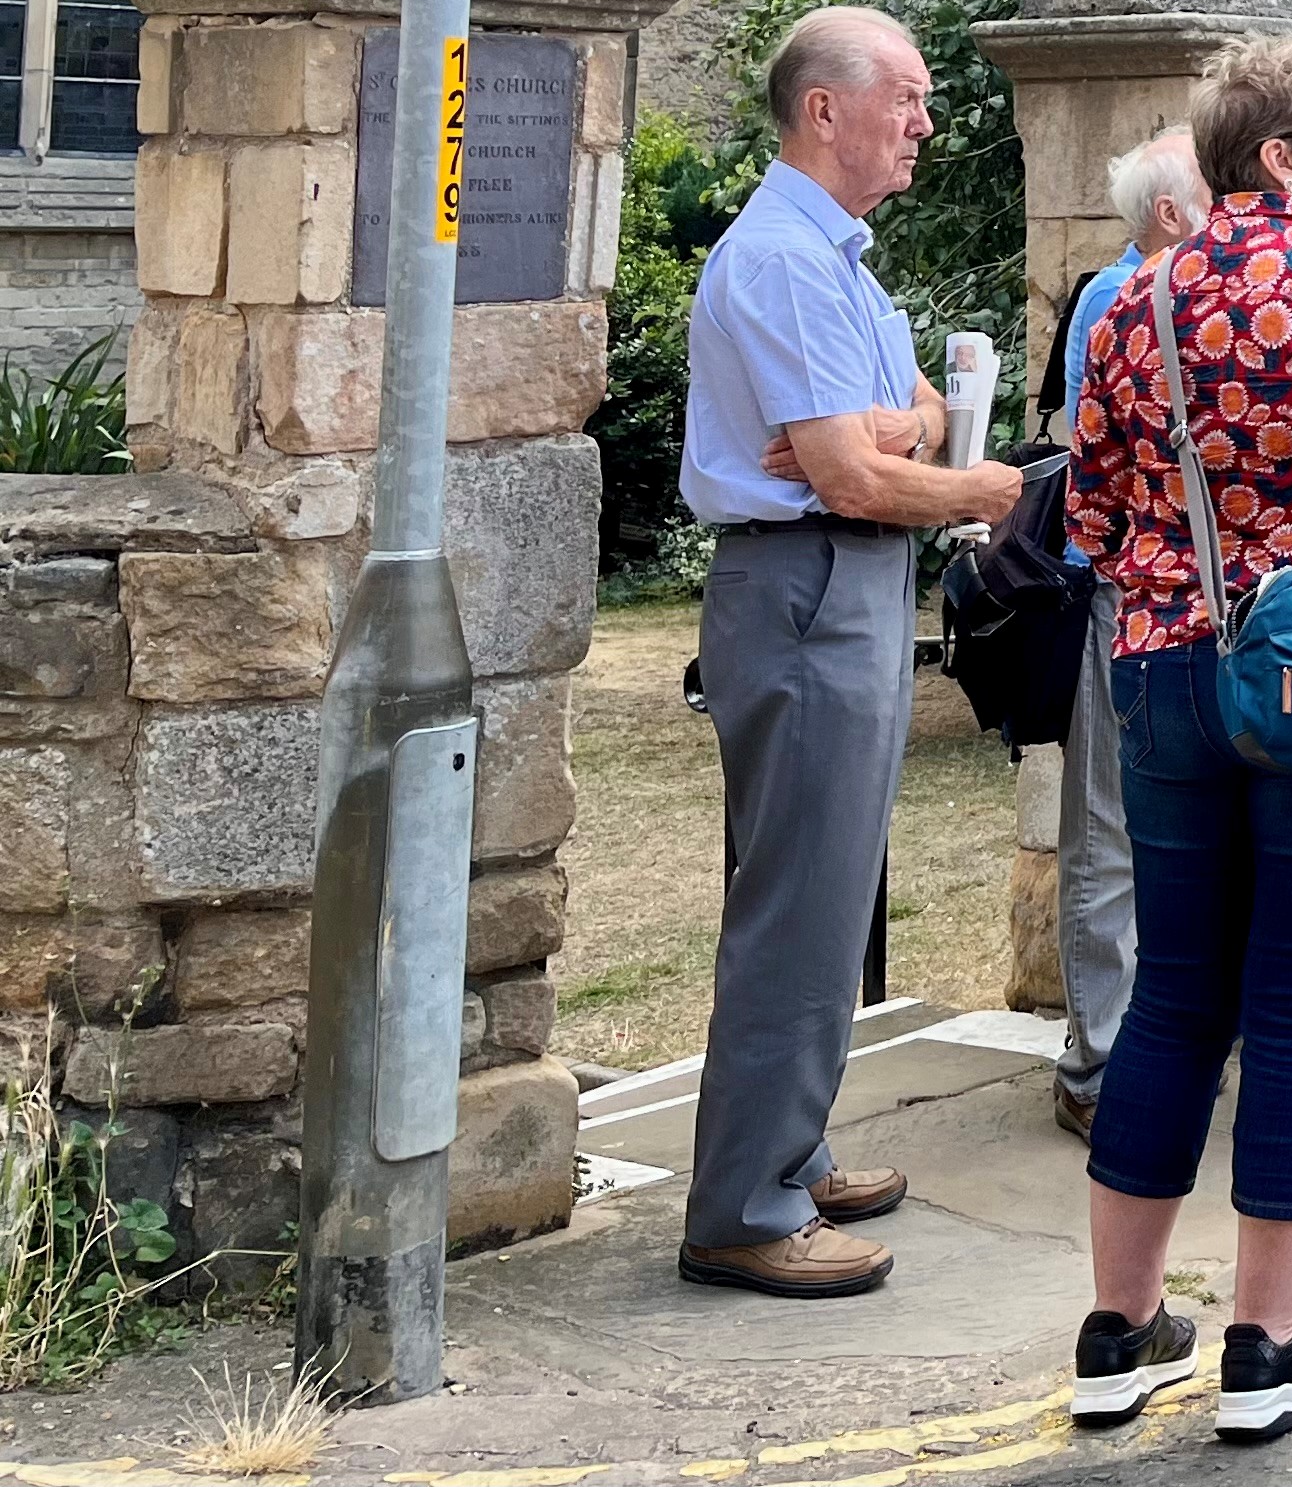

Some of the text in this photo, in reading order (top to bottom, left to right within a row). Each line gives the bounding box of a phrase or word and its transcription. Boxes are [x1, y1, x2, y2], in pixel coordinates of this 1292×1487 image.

[477, 114, 502, 125] THE
[467, 145, 536, 159] CHURCH
[468, 178, 512, 192] FREE
